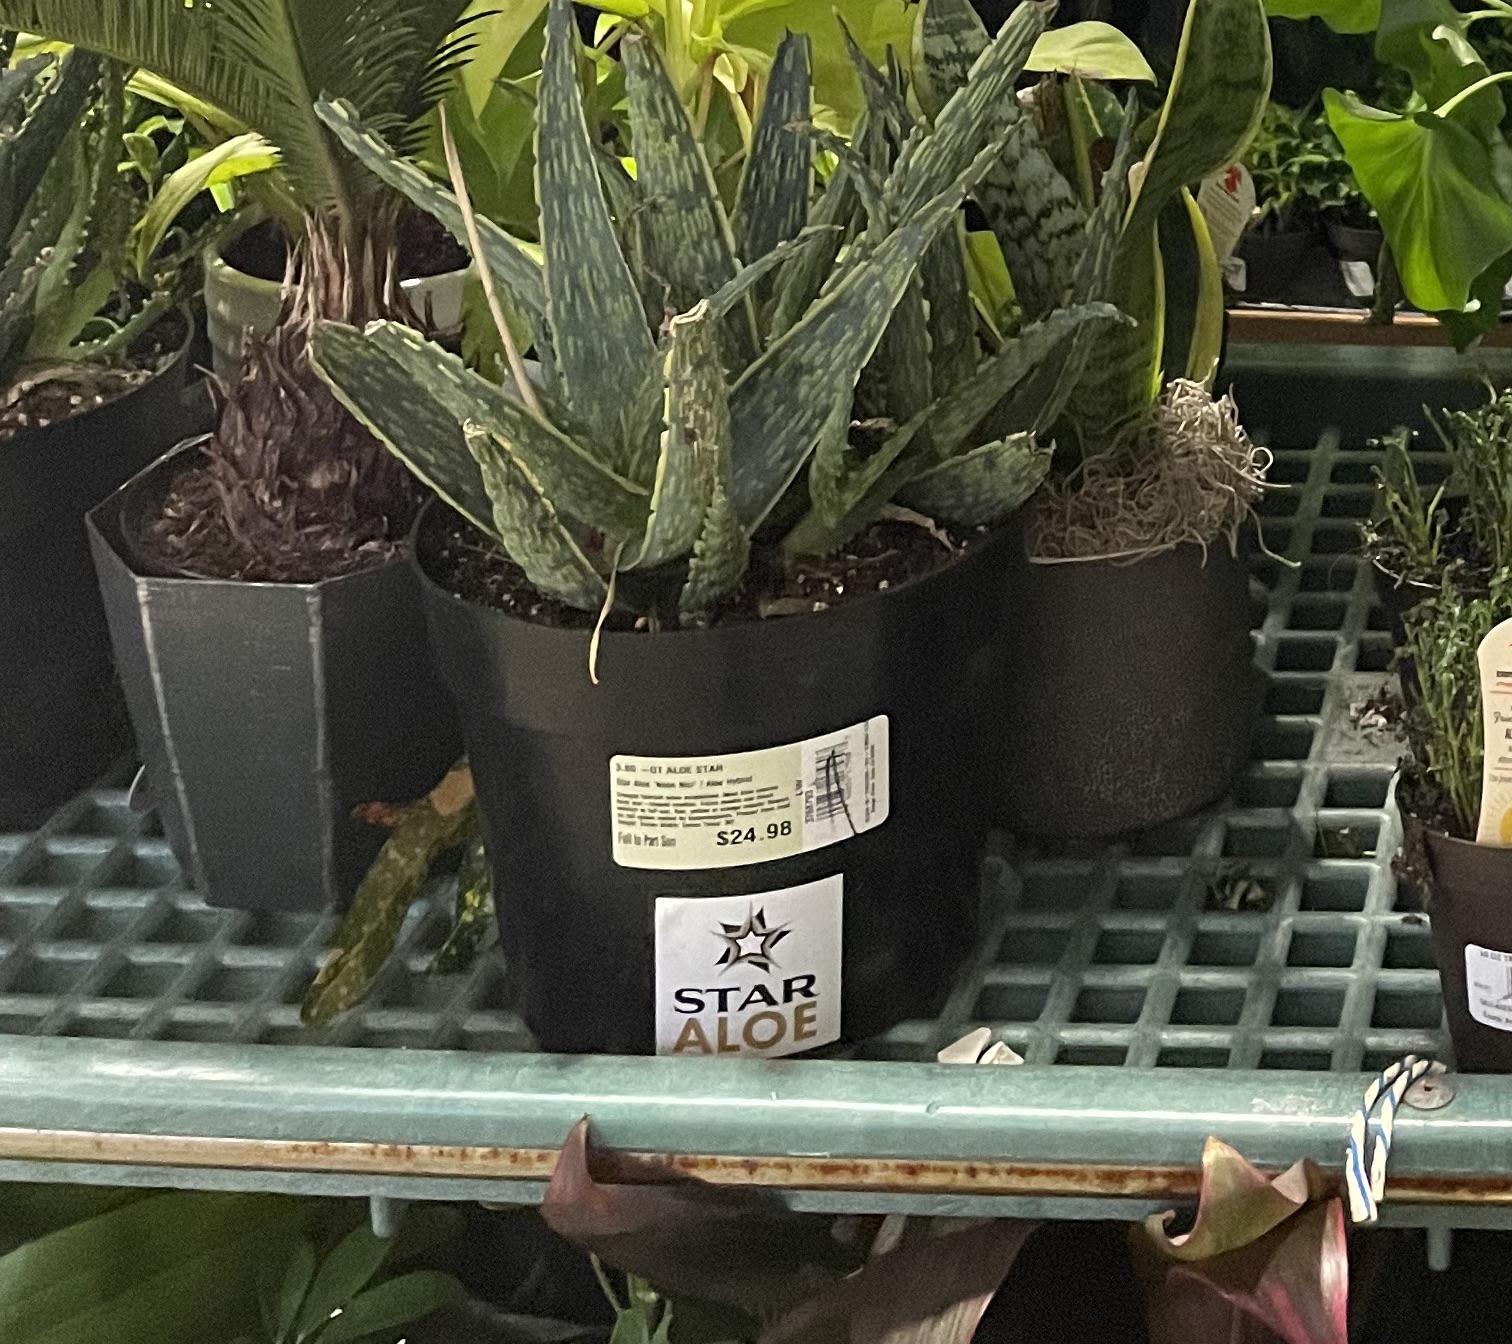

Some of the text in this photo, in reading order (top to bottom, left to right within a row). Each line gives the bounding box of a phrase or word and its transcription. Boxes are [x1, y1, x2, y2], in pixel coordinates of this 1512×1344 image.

[716, 820, 792, 847] $24.98
[674, 973, 820, 1015] STAR
[673, 1000, 818, 1056] ALOE
